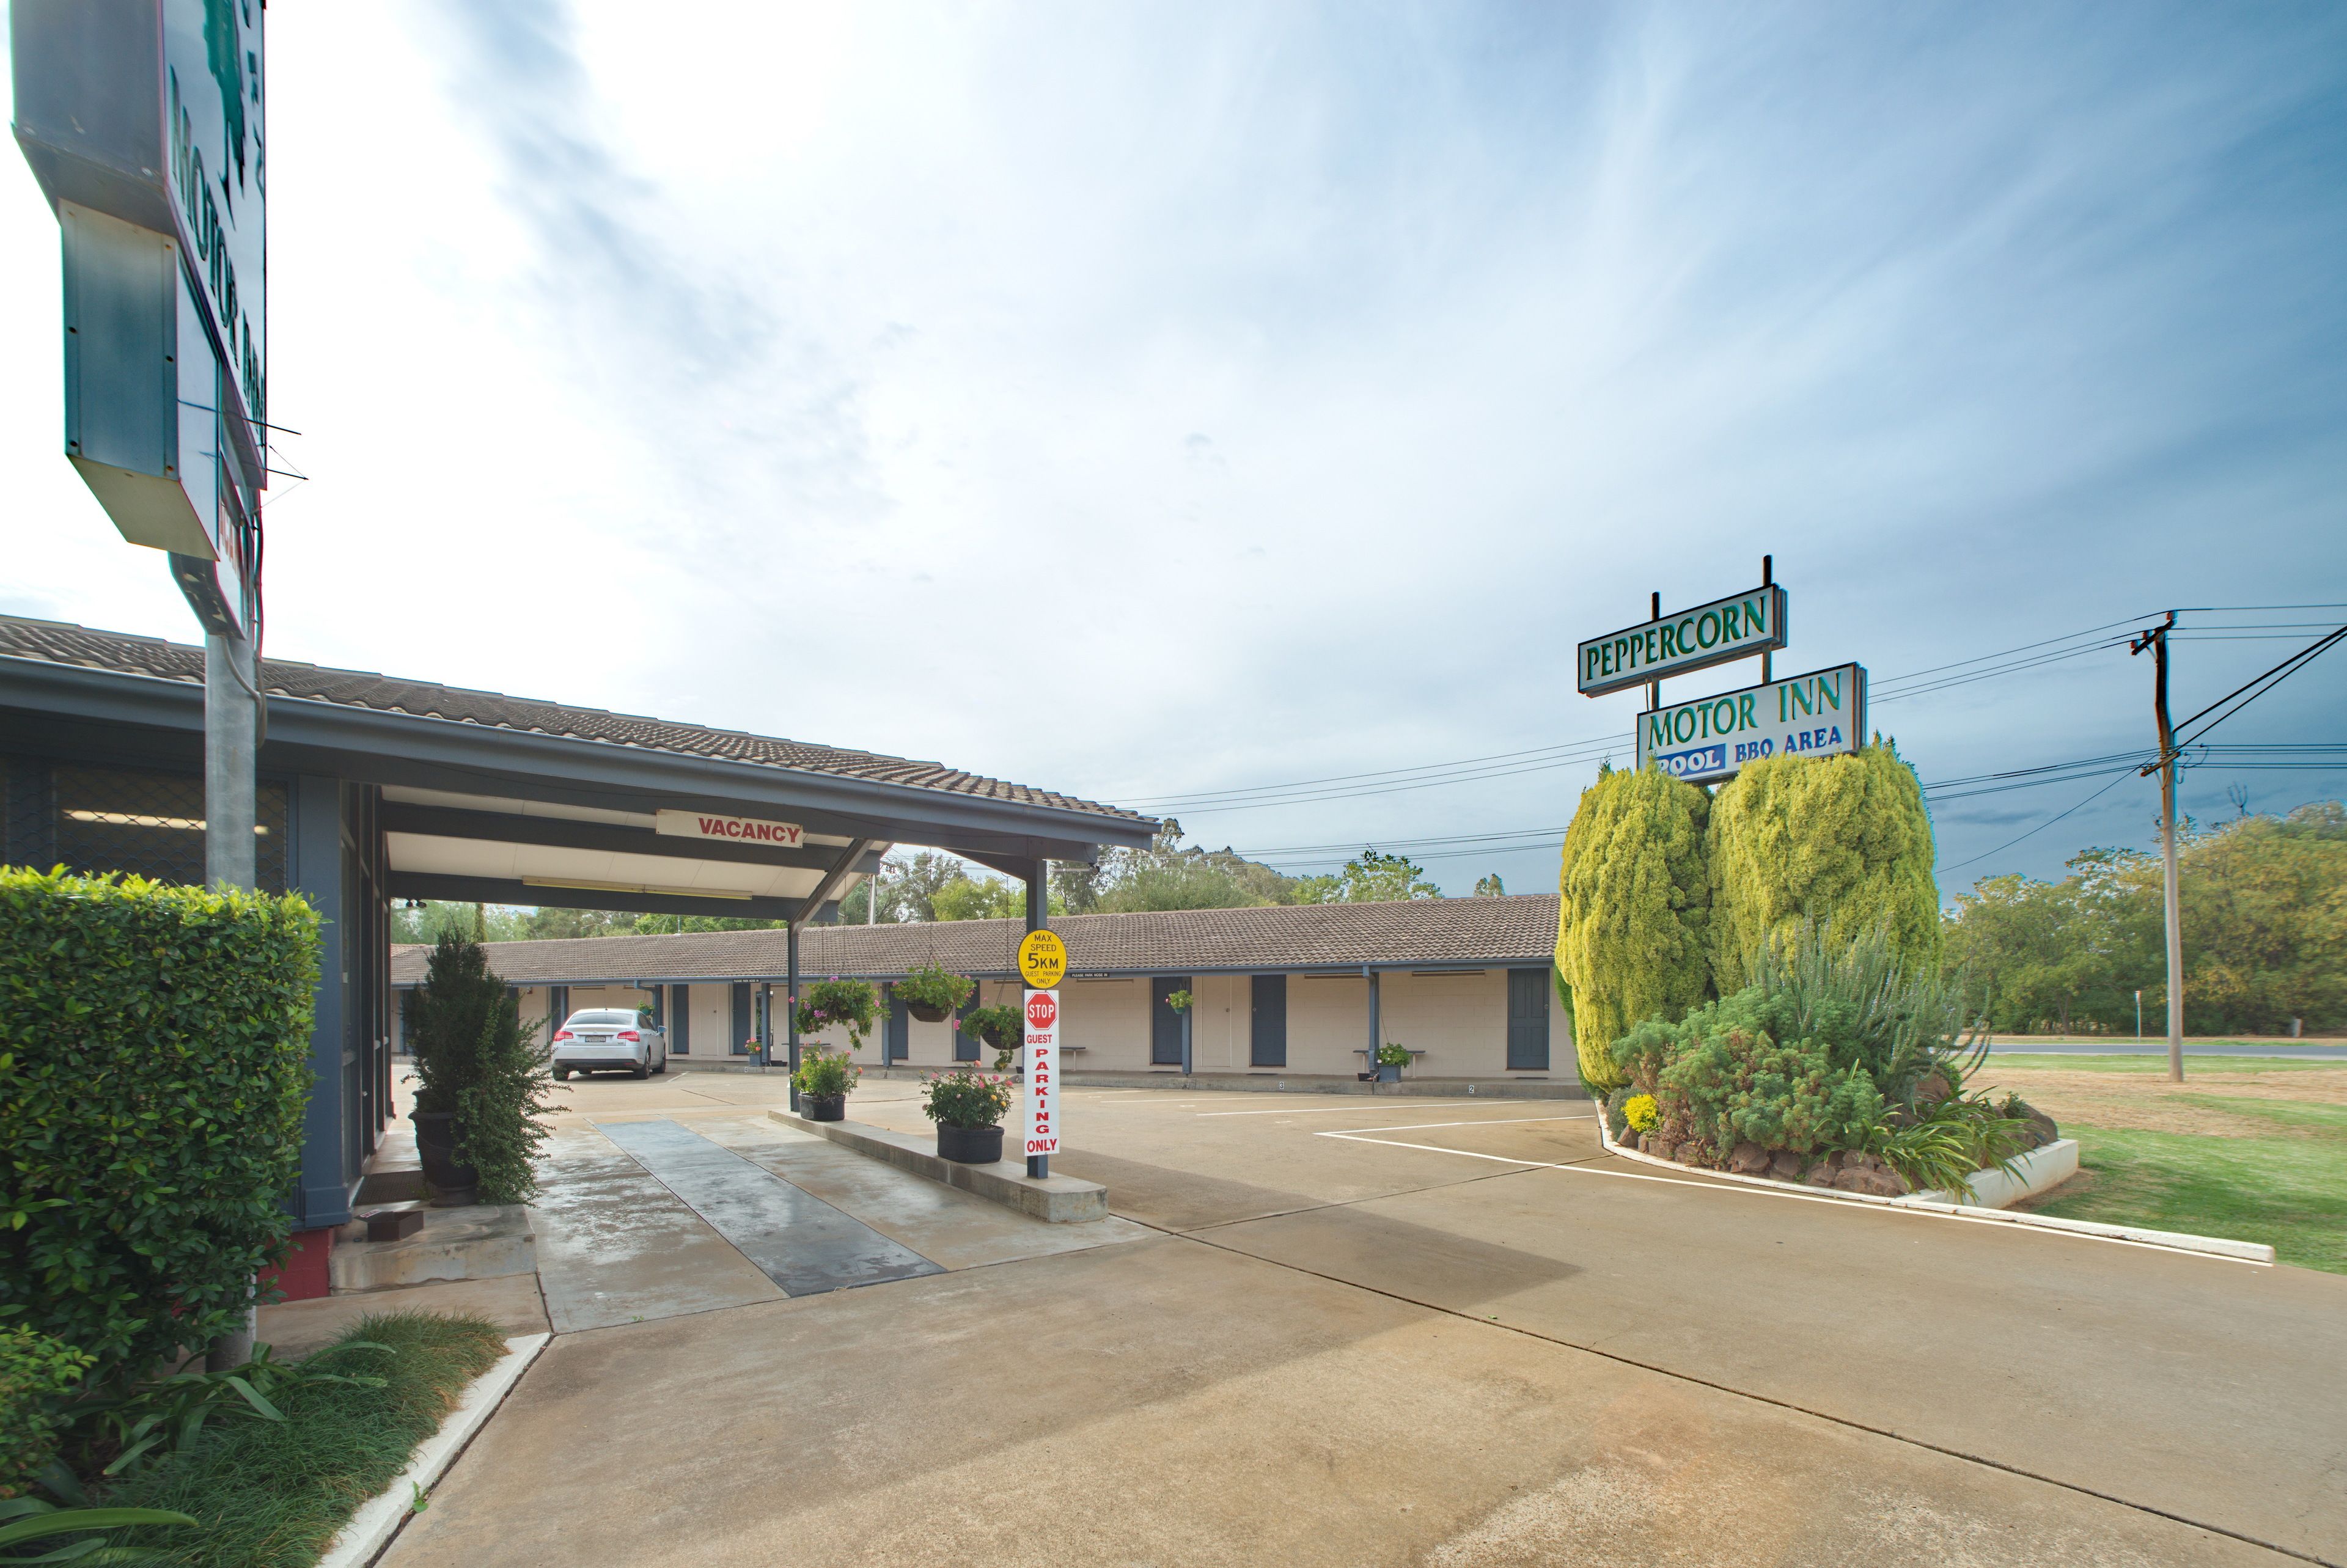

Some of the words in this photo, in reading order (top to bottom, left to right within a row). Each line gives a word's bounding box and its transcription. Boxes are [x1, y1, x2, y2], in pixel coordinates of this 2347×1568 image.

[170, 64, 240, 370] MOTOR
[1586, 595, 1767, 681] PEPPERCORN
[1647, 693, 1758, 750] MOTOR
[1779, 672, 1842, 722] INN
[1656, 749, 1720, 775] POOL
[1734, 738, 1773, 763] BBQ
[1785, 725, 1842, 753] AREA
[698, 818, 801, 843] VACANCY
[1027, 953, 1059, 969] 5KM
[1029, 1004, 1054, 1018] STOP
[1027, 1034, 1052, 1044] GUEST
[1035, 1049, 1049, 1134] PARKING
[1027, 1138, 1057, 1153] ONLY
